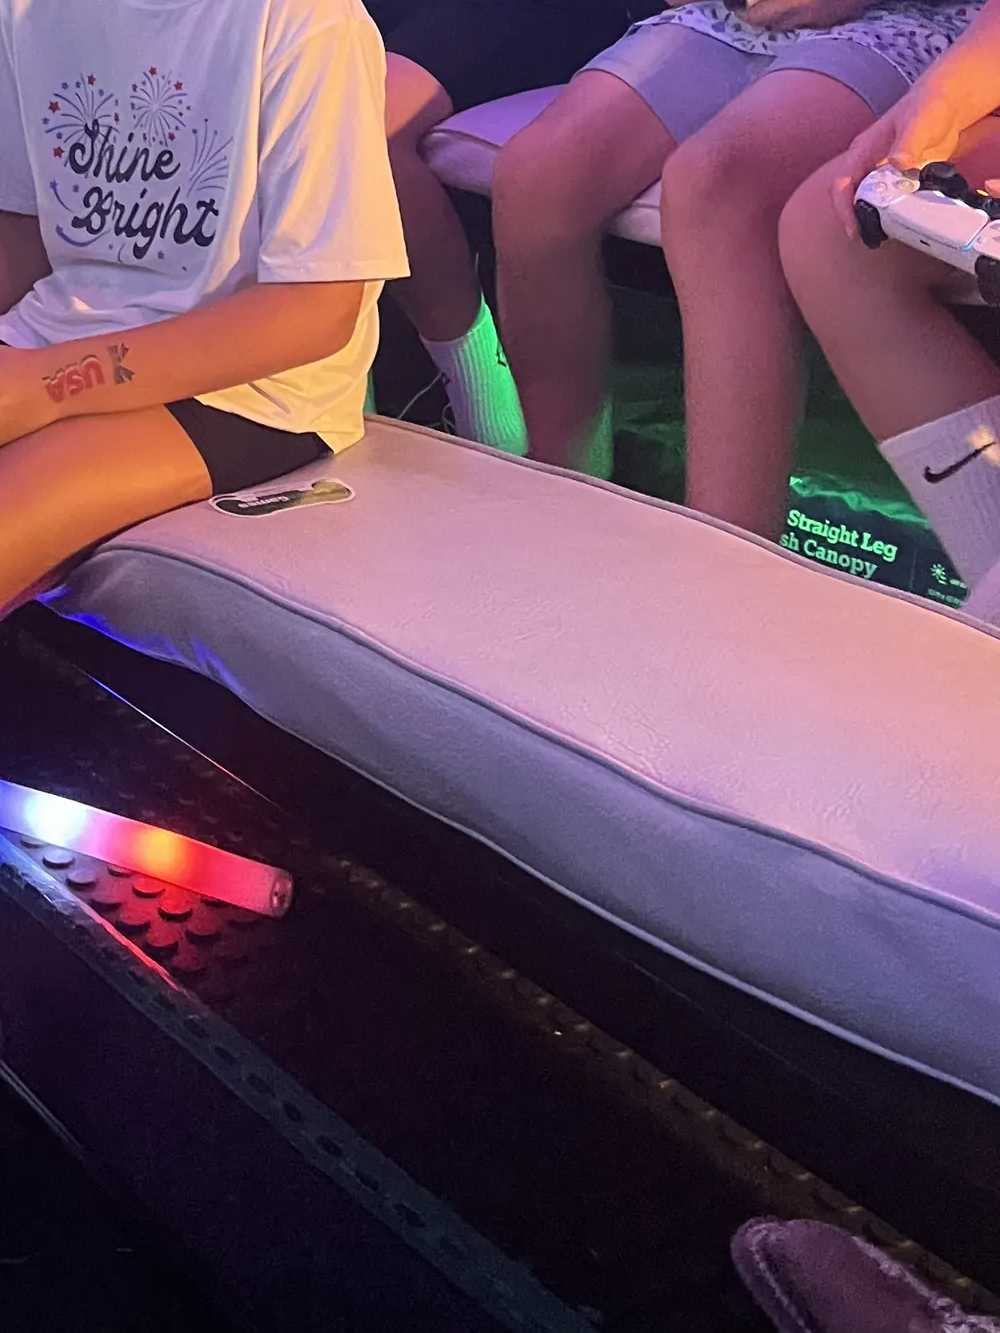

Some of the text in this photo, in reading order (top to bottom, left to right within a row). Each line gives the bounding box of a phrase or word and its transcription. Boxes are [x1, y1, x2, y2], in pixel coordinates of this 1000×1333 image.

[68, 118, 181, 184] Shine
[70, 186, 220, 260] Bright
[41, 354, 105, 403] USA
[786, 509, 899, 563] Straight Leg
[803, 539, 878, 580] Canopy
